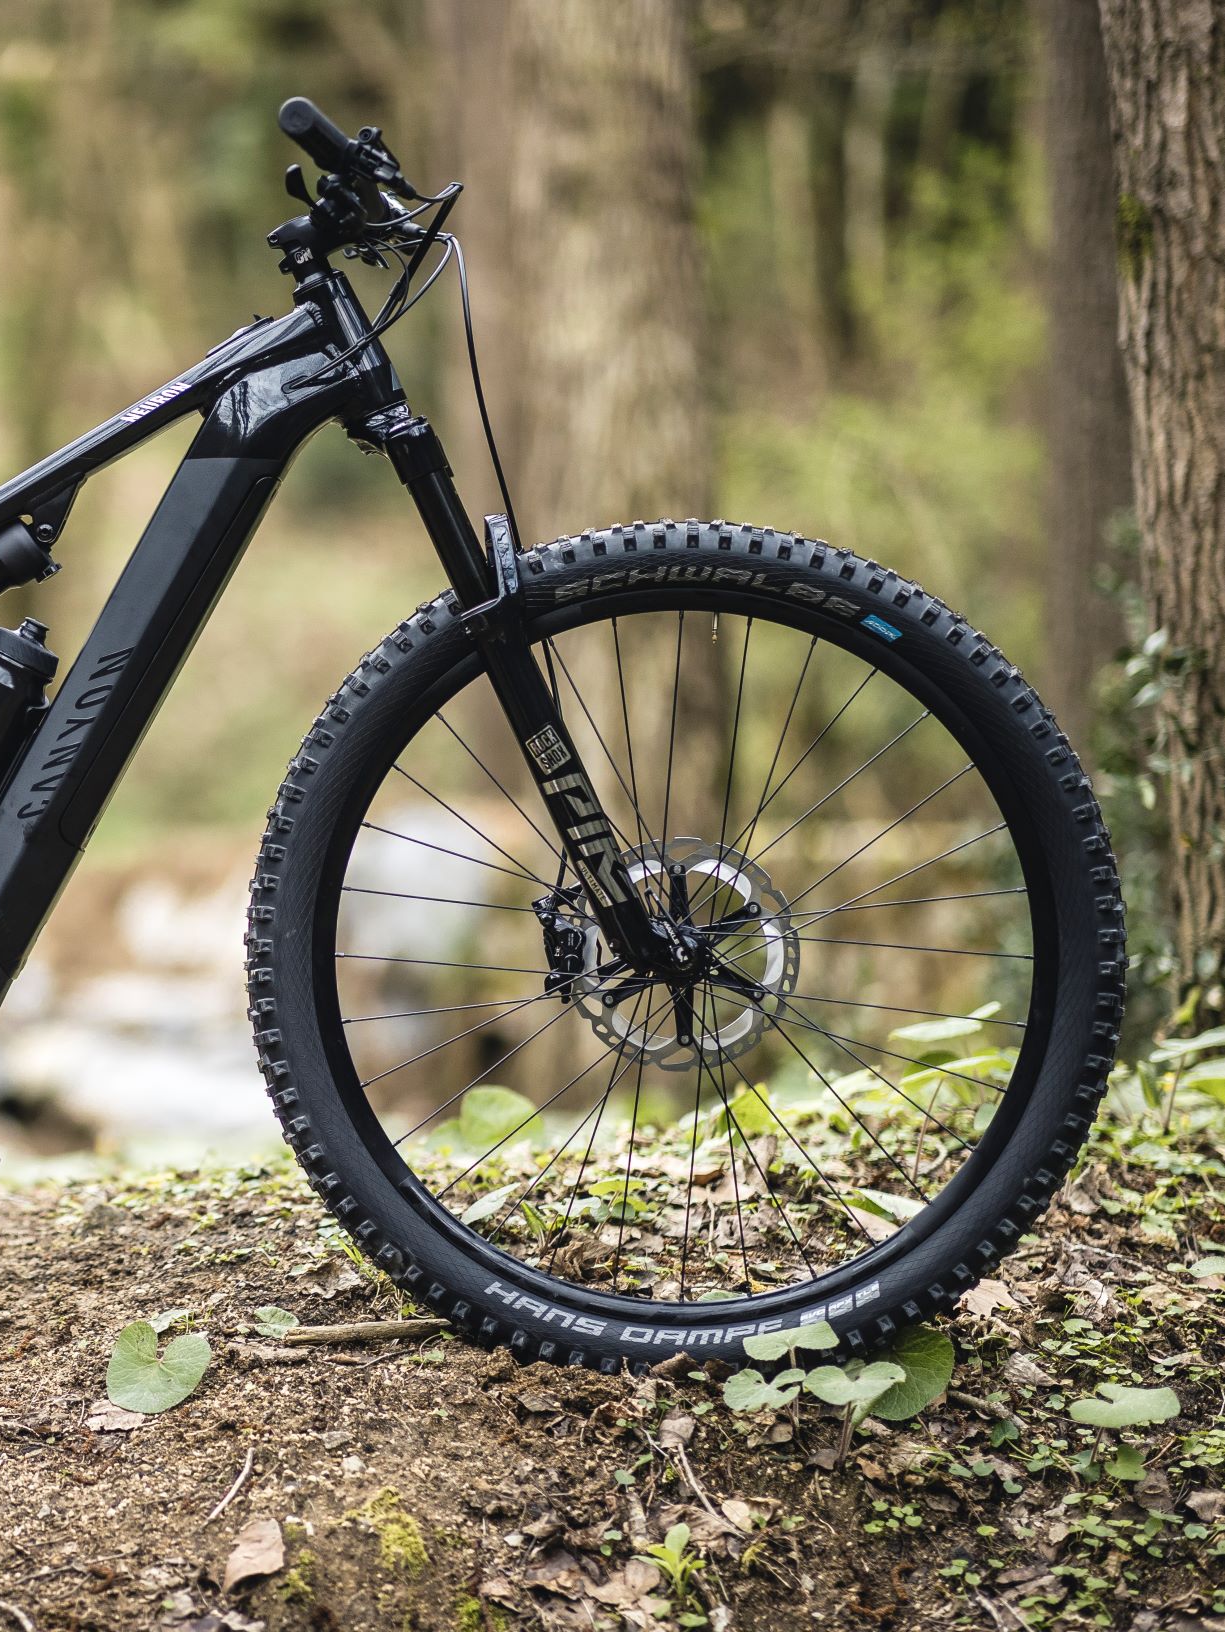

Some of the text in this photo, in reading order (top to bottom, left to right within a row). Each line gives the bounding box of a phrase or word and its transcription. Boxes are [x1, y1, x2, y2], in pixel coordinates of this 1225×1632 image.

[119, 381, 192, 423] NEURON
[553, 566, 861, 618] SCHWALBE
[16, 645, 137, 820] CANYON
[528, 728, 558, 759] ROCK
[540, 744, 568, 770] SHOX
[581, 866, 607, 902] ULTIMATE
[483, 1281, 608, 1336] HANS
[619, 1318, 783, 1346] DAMPF
